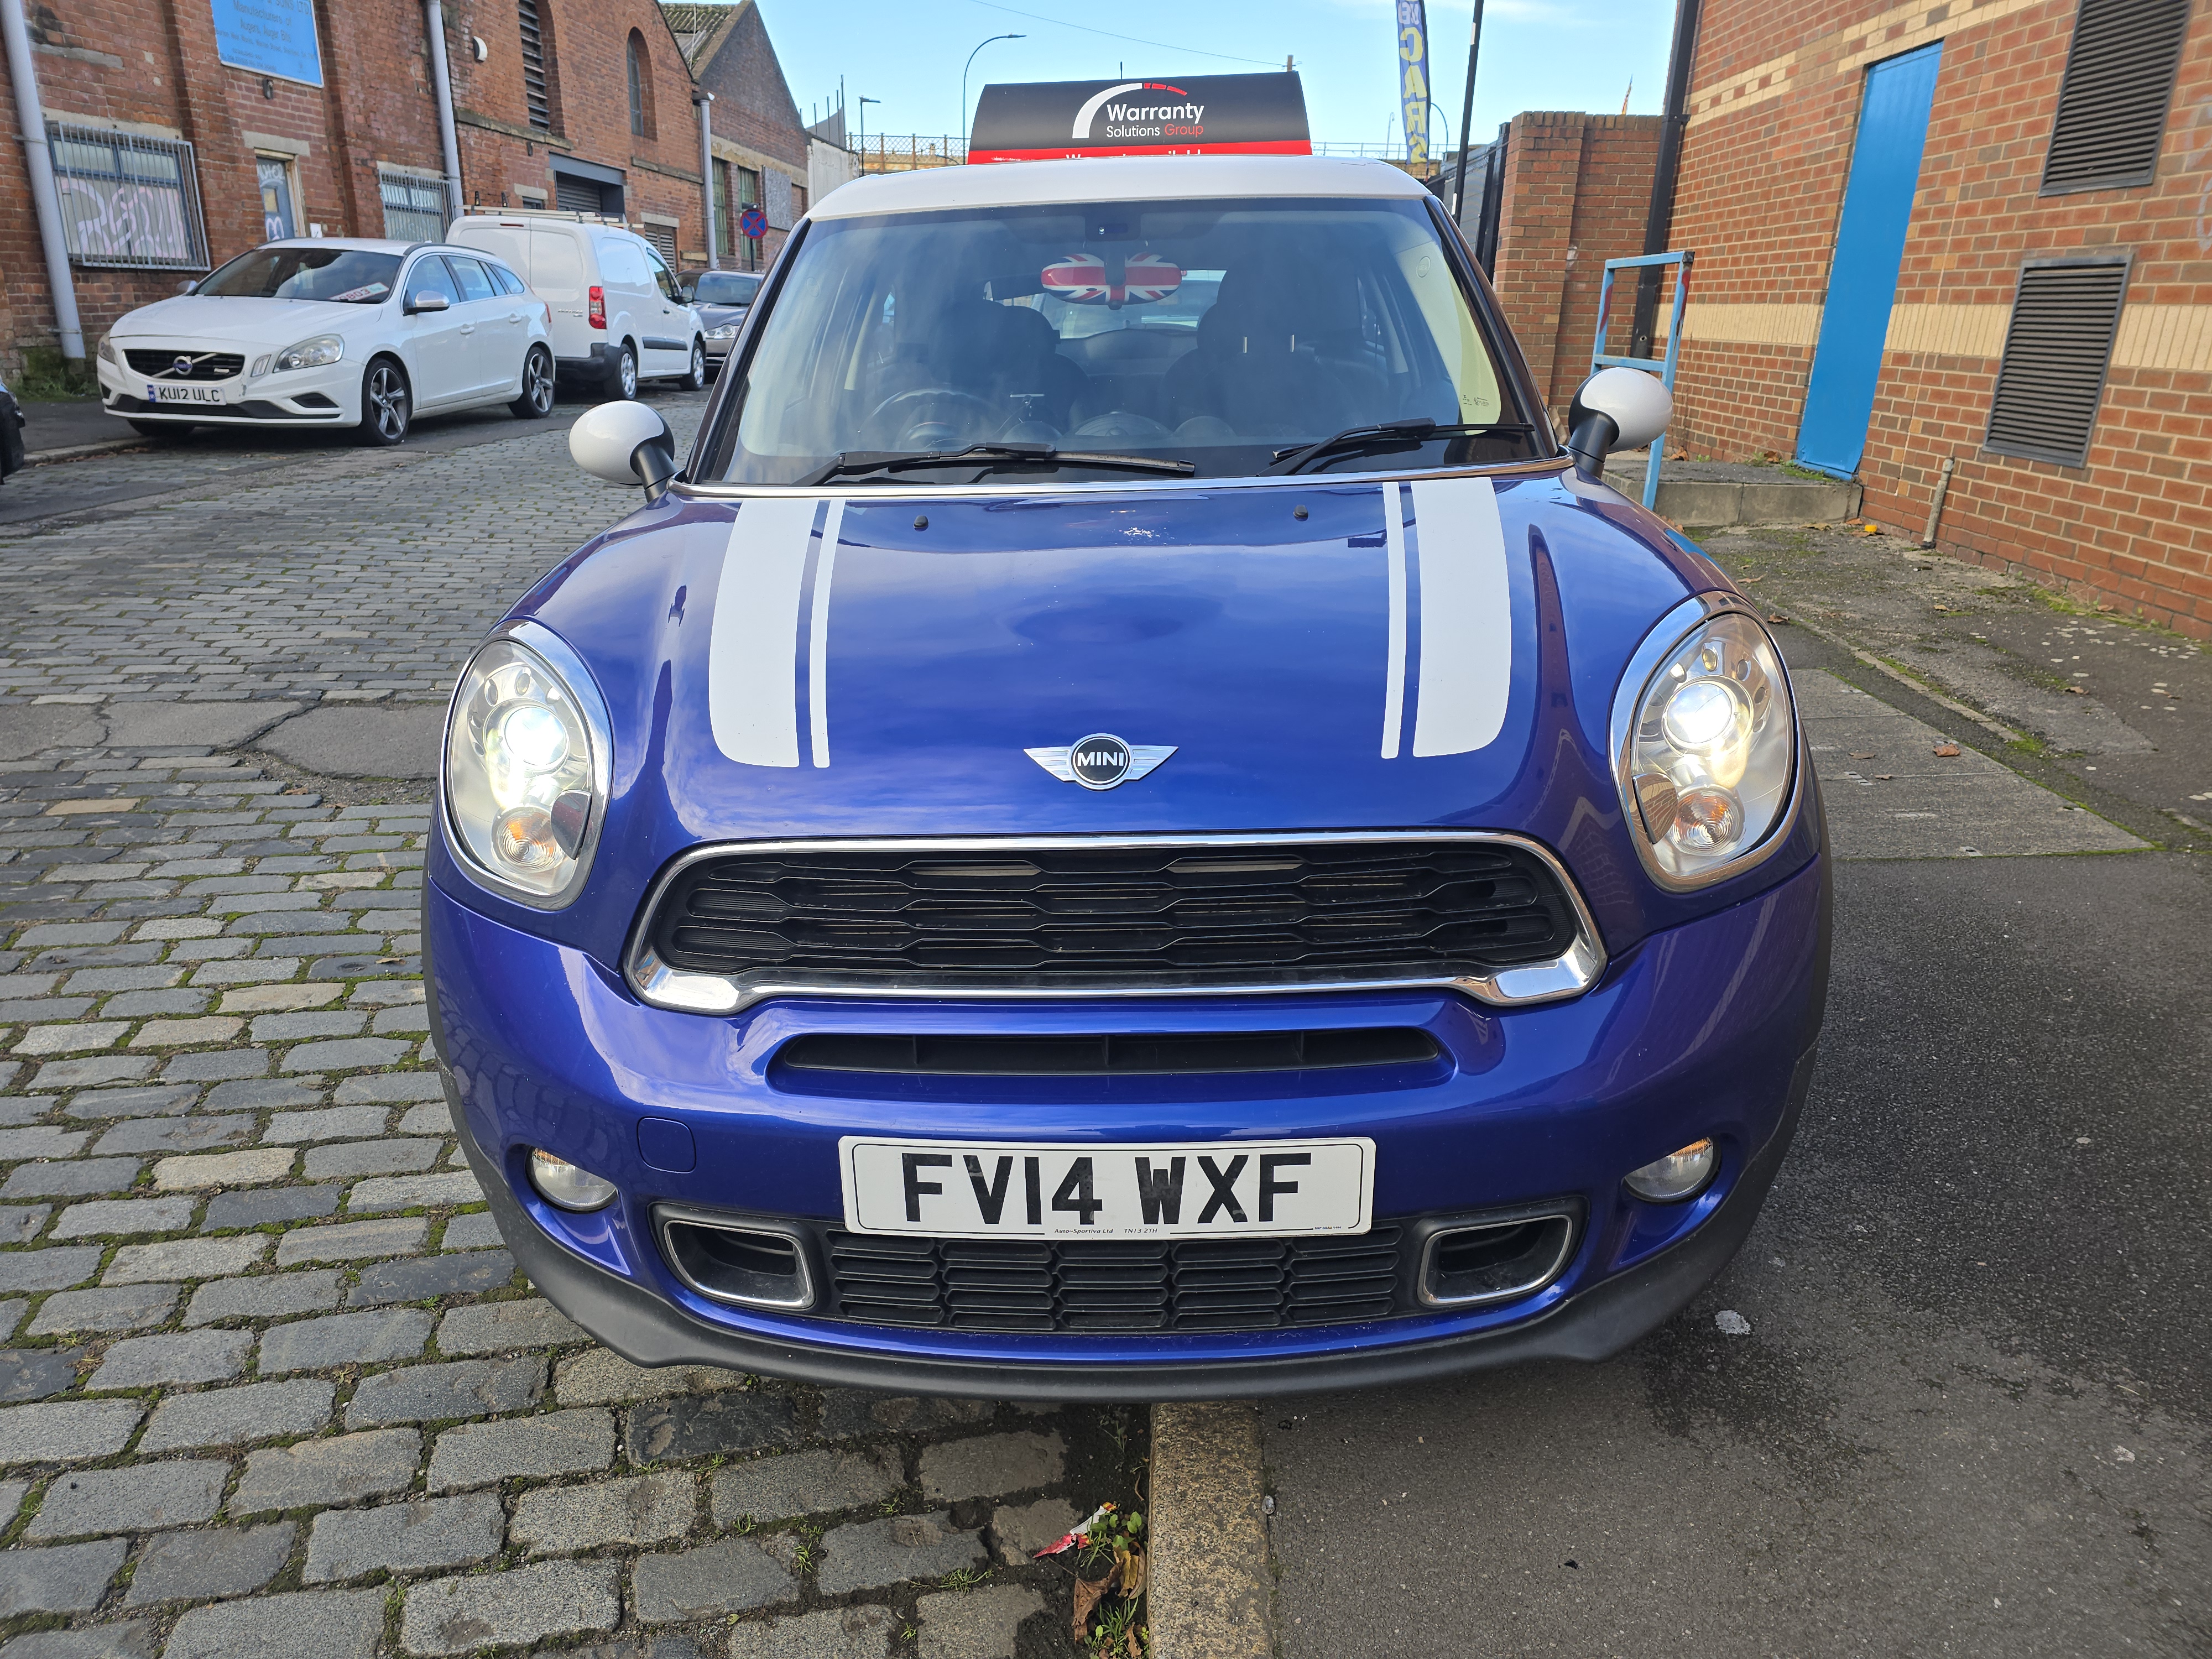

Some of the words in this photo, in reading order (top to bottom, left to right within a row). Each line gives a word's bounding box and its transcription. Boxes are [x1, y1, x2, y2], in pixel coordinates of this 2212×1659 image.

[1107, 103, 1204, 124] Warranty
[1107, 125, 1160, 137] Solutions
[1165, 123, 1204, 138] Group
[159, 387, 190, 400] KU12
[193, 388, 220, 402] ULC
[1078, 752, 1124, 766] MINI
[902, 1152, 1103, 1225] FV14
[1135, 1152, 1312, 1224] WXF
